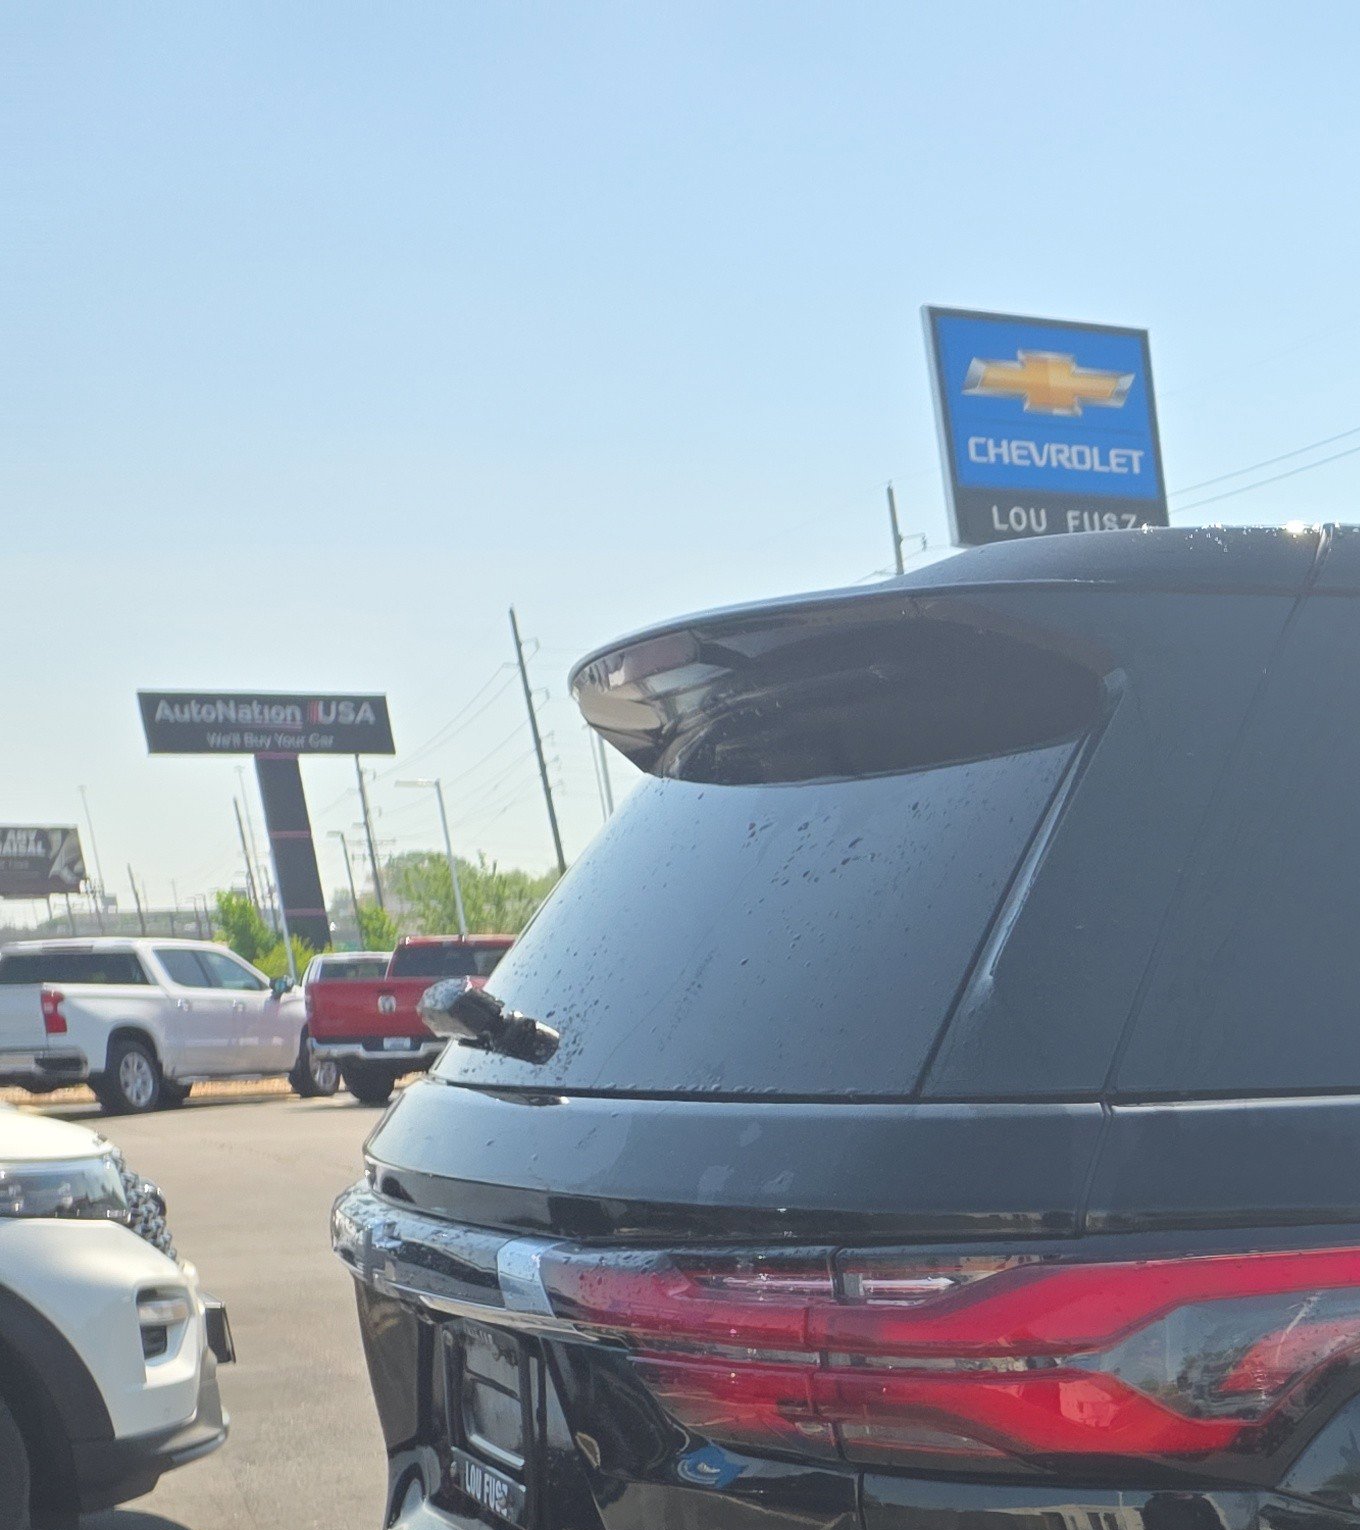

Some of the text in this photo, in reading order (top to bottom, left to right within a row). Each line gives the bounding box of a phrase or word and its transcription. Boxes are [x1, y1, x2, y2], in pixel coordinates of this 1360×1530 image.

[967, 436, 1144, 474] CHEVROLET
[992, 505, 1048, 533] LOU
[155, 700, 376, 725] AutoNation USA
[244, 732, 271, 748] Buy
[274, 732, 305, 748] Your
[308, 732, 334, 748] Car
[465, 1461, 482, 1501] LOU
